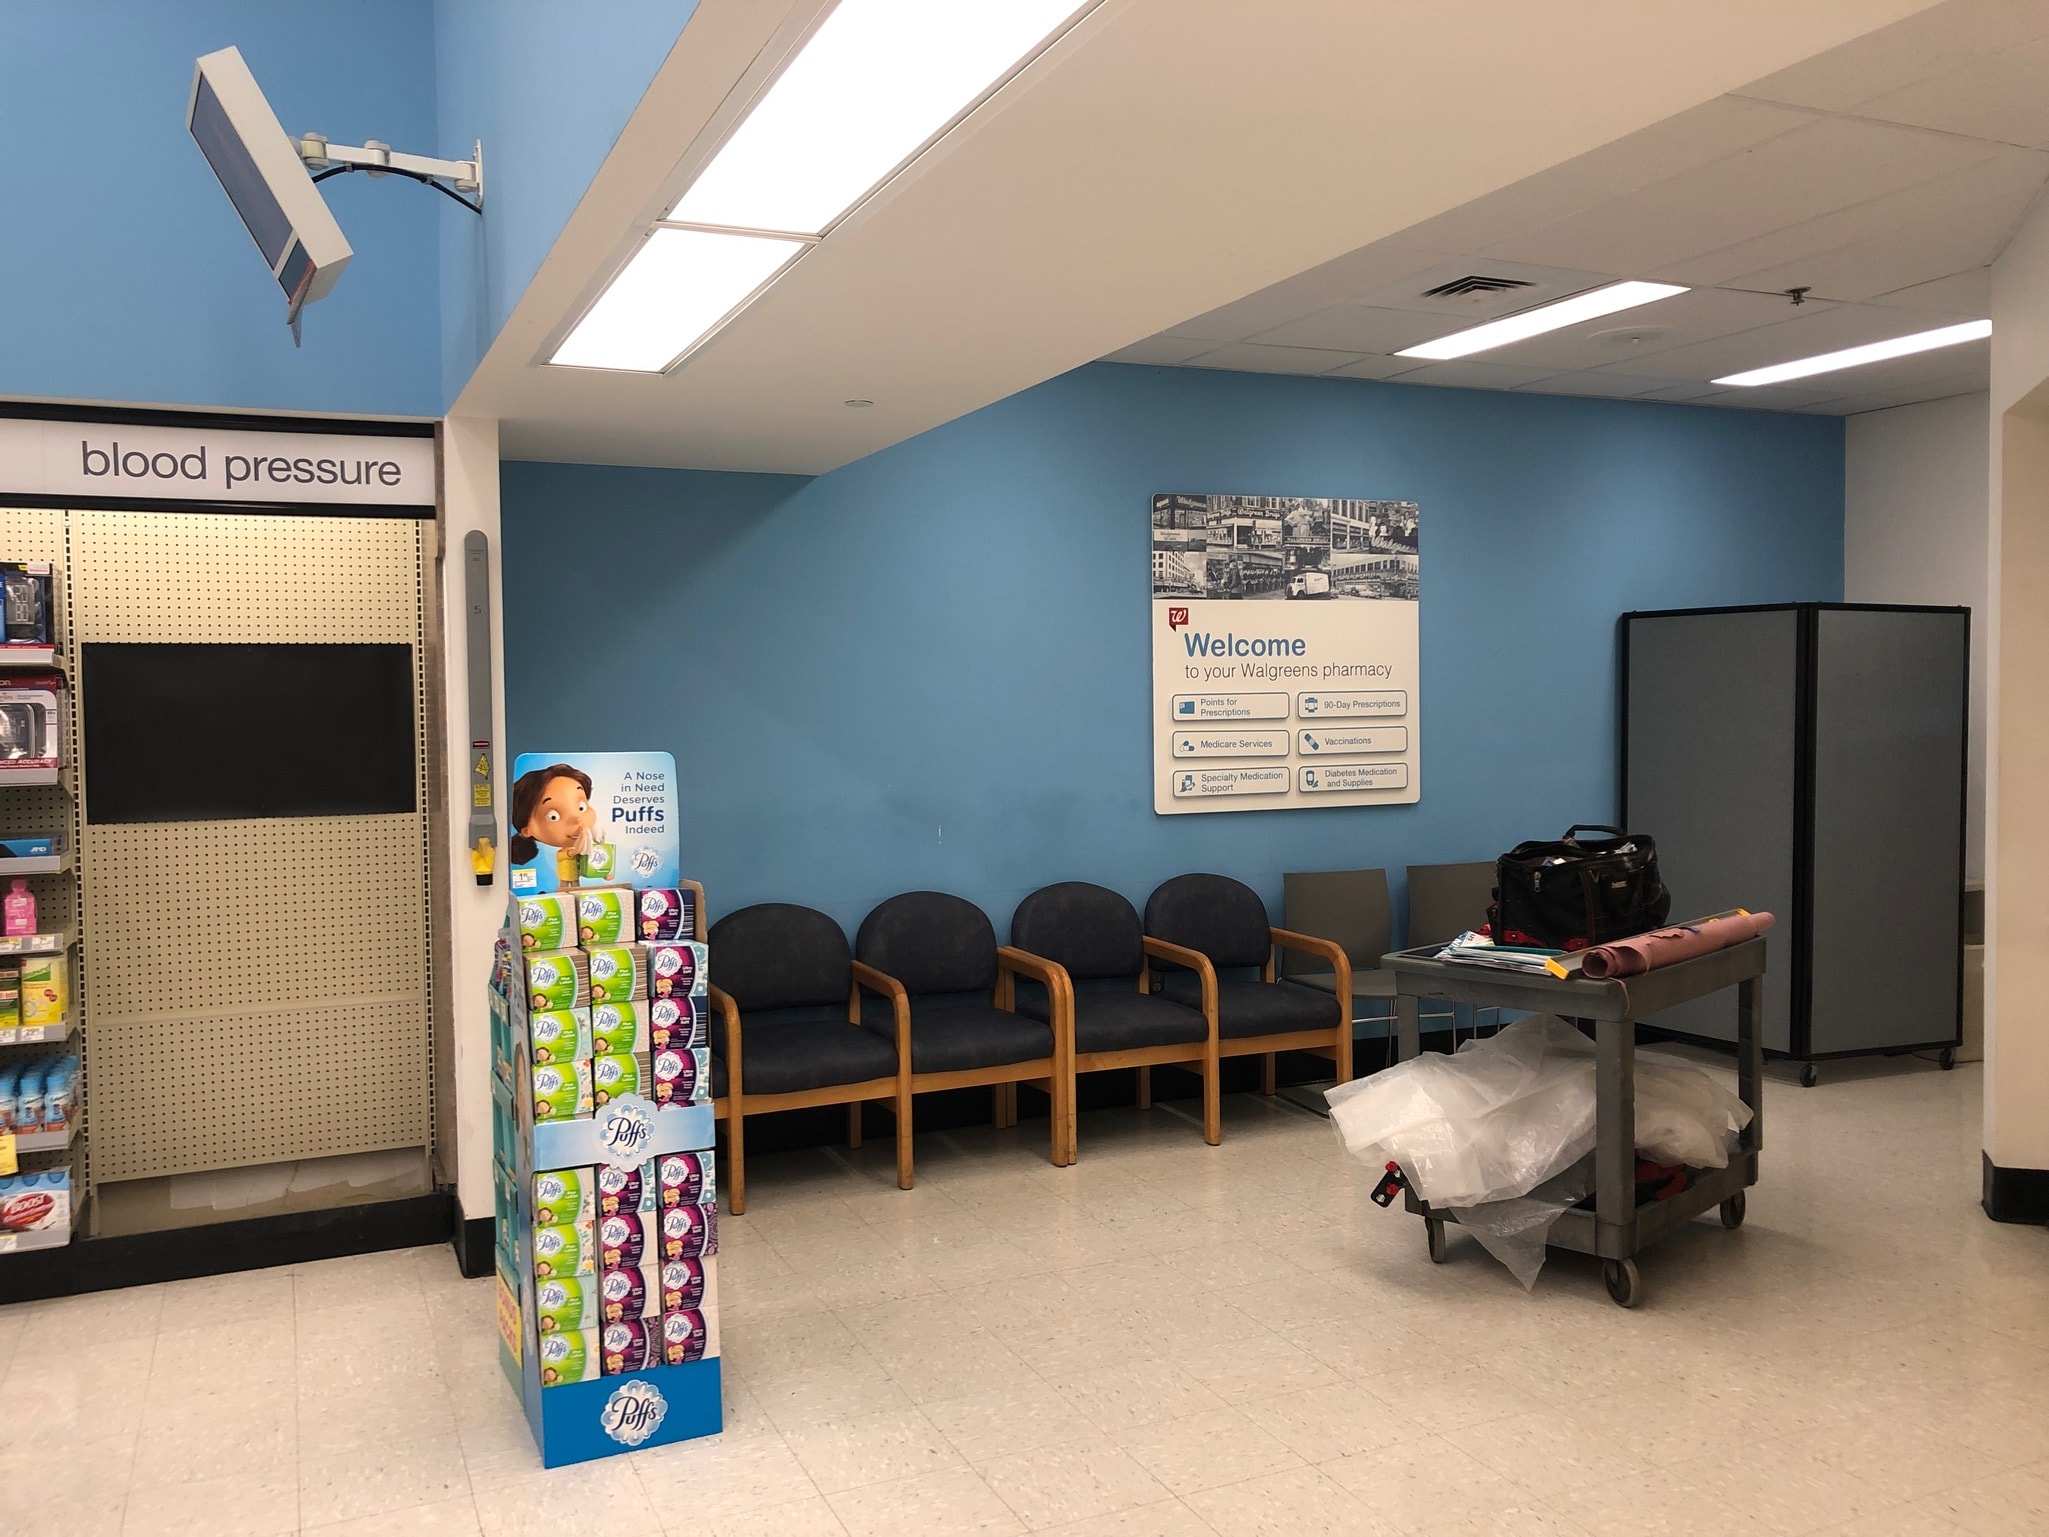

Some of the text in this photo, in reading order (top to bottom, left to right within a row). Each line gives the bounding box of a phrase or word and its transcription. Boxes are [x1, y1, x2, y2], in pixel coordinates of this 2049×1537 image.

[82, 441, 402, 490] blood pressure
[1184, 632, 1306, 657] Welcome
[1185, 662, 1393, 682] to your Walgreens pharmacy
[1200, 698, 1238, 706] Points for
[1324, 700, 1401, 710] 90-Day Prescriptions
[1200, 708, 1251, 717] Prescriptions
[1200, 739, 1273, 748] Medicare Services
[1324, 737, 1372, 746] Vaccinations
[624, 771, 665, 781] A Nose
[1201, 772, 1284, 783] Specialty Medication
[1324, 768, 1398, 777] Diabetes Medication
[621, 783, 665, 792] in Need
[1201, 784, 1234, 794] Support
[1327, 779, 1374, 788] and Supplies
[613, 795, 665, 804] Deserves
[612, 807, 665, 822] Puffs
[625, 825, 665, 834] Indeed
[634, 853, 658, 871] Puffs
[581, 900, 603, 917] Puffs
[643, 897, 664, 914] Puffs
[521, 907, 544, 923] Puffs
[592, 959, 614, 975] Puffs
[657, 954, 678, 971] Puffs
[532, 967, 555, 983] Puffs
[595, 1011, 618, 1028] Puffs
[655, 1005, 676, 1021] Puffs
[535, 1020, 558, 1037] Puffs
[597, 1064, 619, 1080] Puffs
[658, 1058, 679, 1075] Puffs
[536, 1073, 559, 1090] Puffs
[607, 1116, 647, 1148] Puffs
[602, 1171, 624, 1187] Puffs
[664, 1164, 685, 1180] Puffs
[540, 1181, 562, 1197] Puffs
[666, 1216, 687, 1232] Puffs
[604, 1224, 626, 1241] Puffs
[538, 1234, 561, 1251] Puffs
[665, 1267, 687, 1283] Puffs
[606, 1279, 627, 1295] Puffs
[542, 1288, 564, 1305] Puffs
[667, 1320, 688, 1337] Puffs
[606, 1330, 628, 1346] Puffs
[544, 1341, 567, 1358] Puffs
[611, 1396, 658, 1431] Puffs
